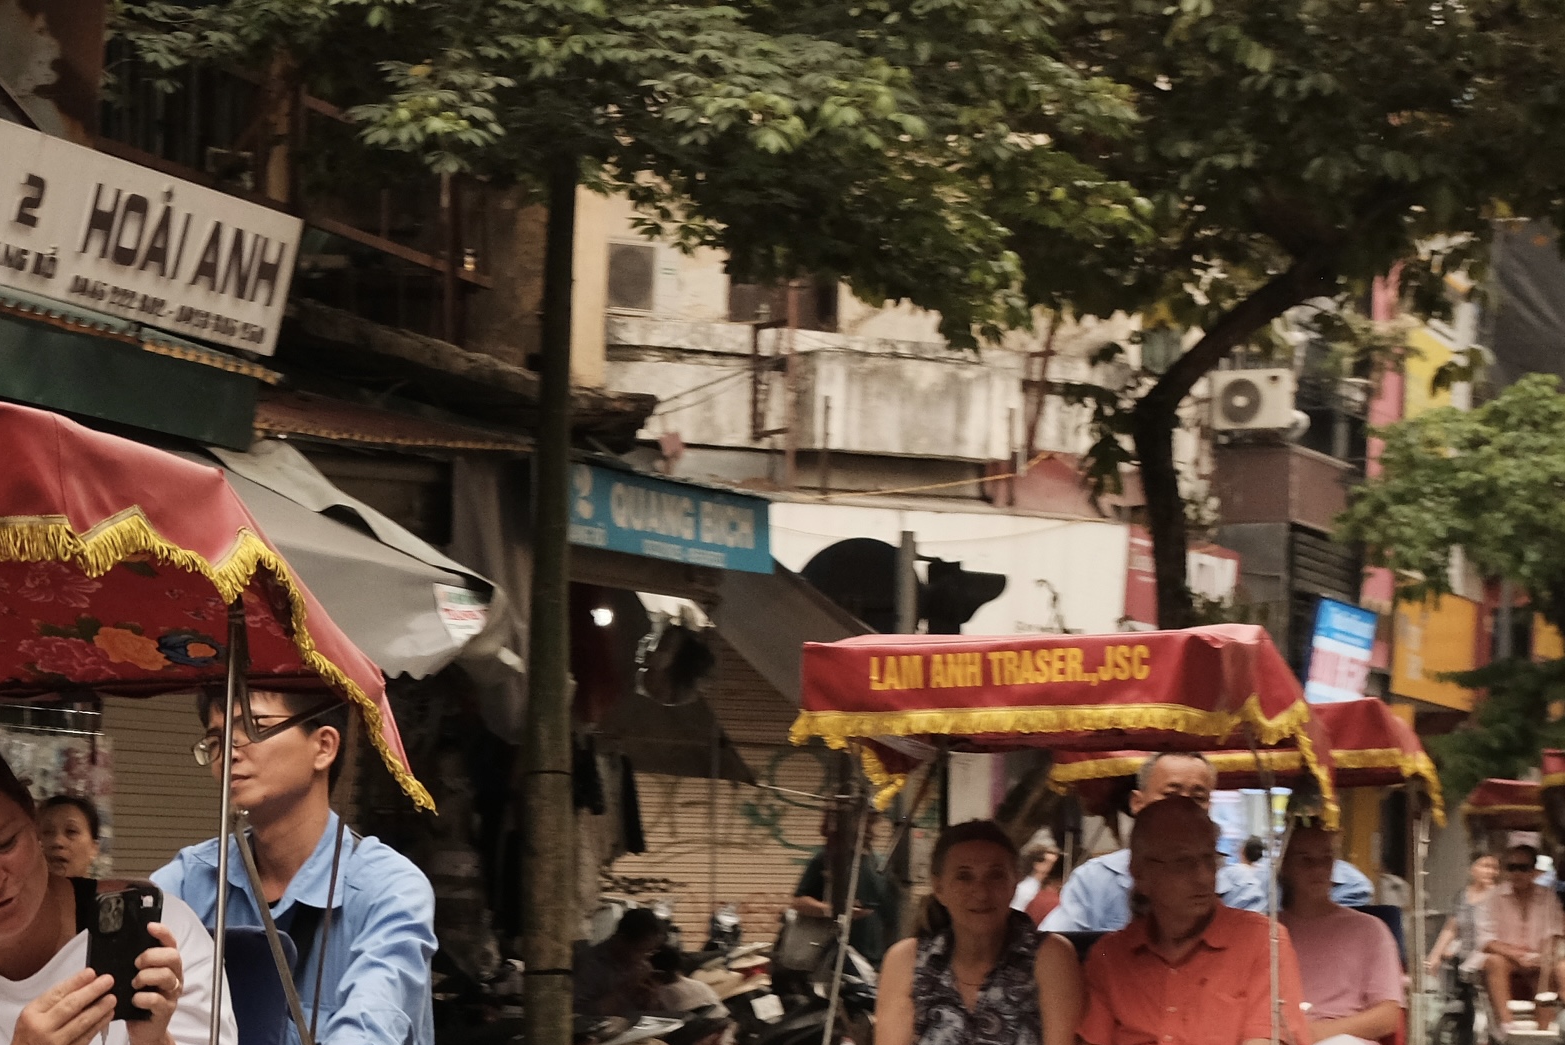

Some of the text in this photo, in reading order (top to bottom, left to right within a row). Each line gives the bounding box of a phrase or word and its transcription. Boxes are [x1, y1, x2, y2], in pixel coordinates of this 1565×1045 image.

[11, 172, 47, 227] 2
[188, 219, 287, 307] ANH
[869, 655, 924, 691] LAM
[929, 652, 983, 688] ANH
